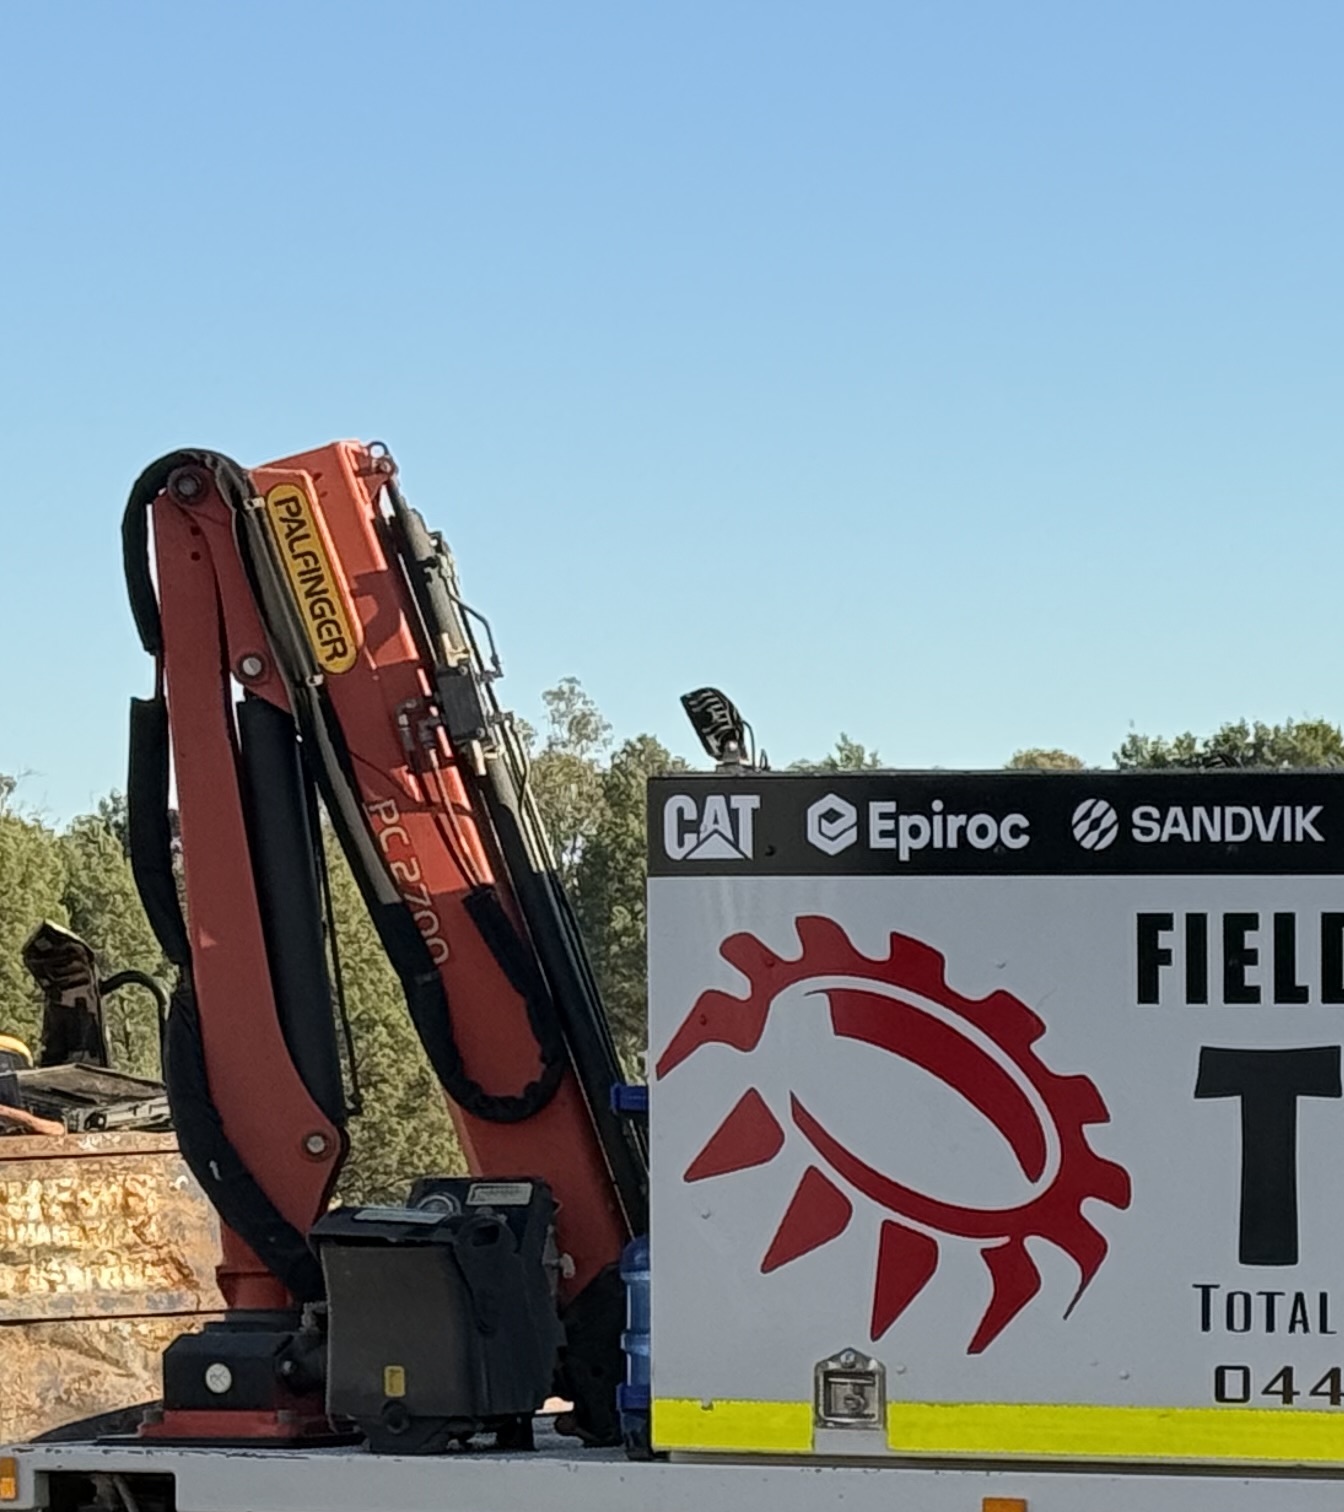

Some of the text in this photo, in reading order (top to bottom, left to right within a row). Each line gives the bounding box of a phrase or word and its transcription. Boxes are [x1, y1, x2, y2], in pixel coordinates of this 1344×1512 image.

[273, 496, 349, 662] PALFINGER
[369, 800, 410, 852] PC
[664, 795, 760, 860] CAT
[869, 800, 1030, 861] Epiroc
[1131, 805, 1325, 843] SANDVIK
[1193, 1283, 1337, 1335] TOTAL
